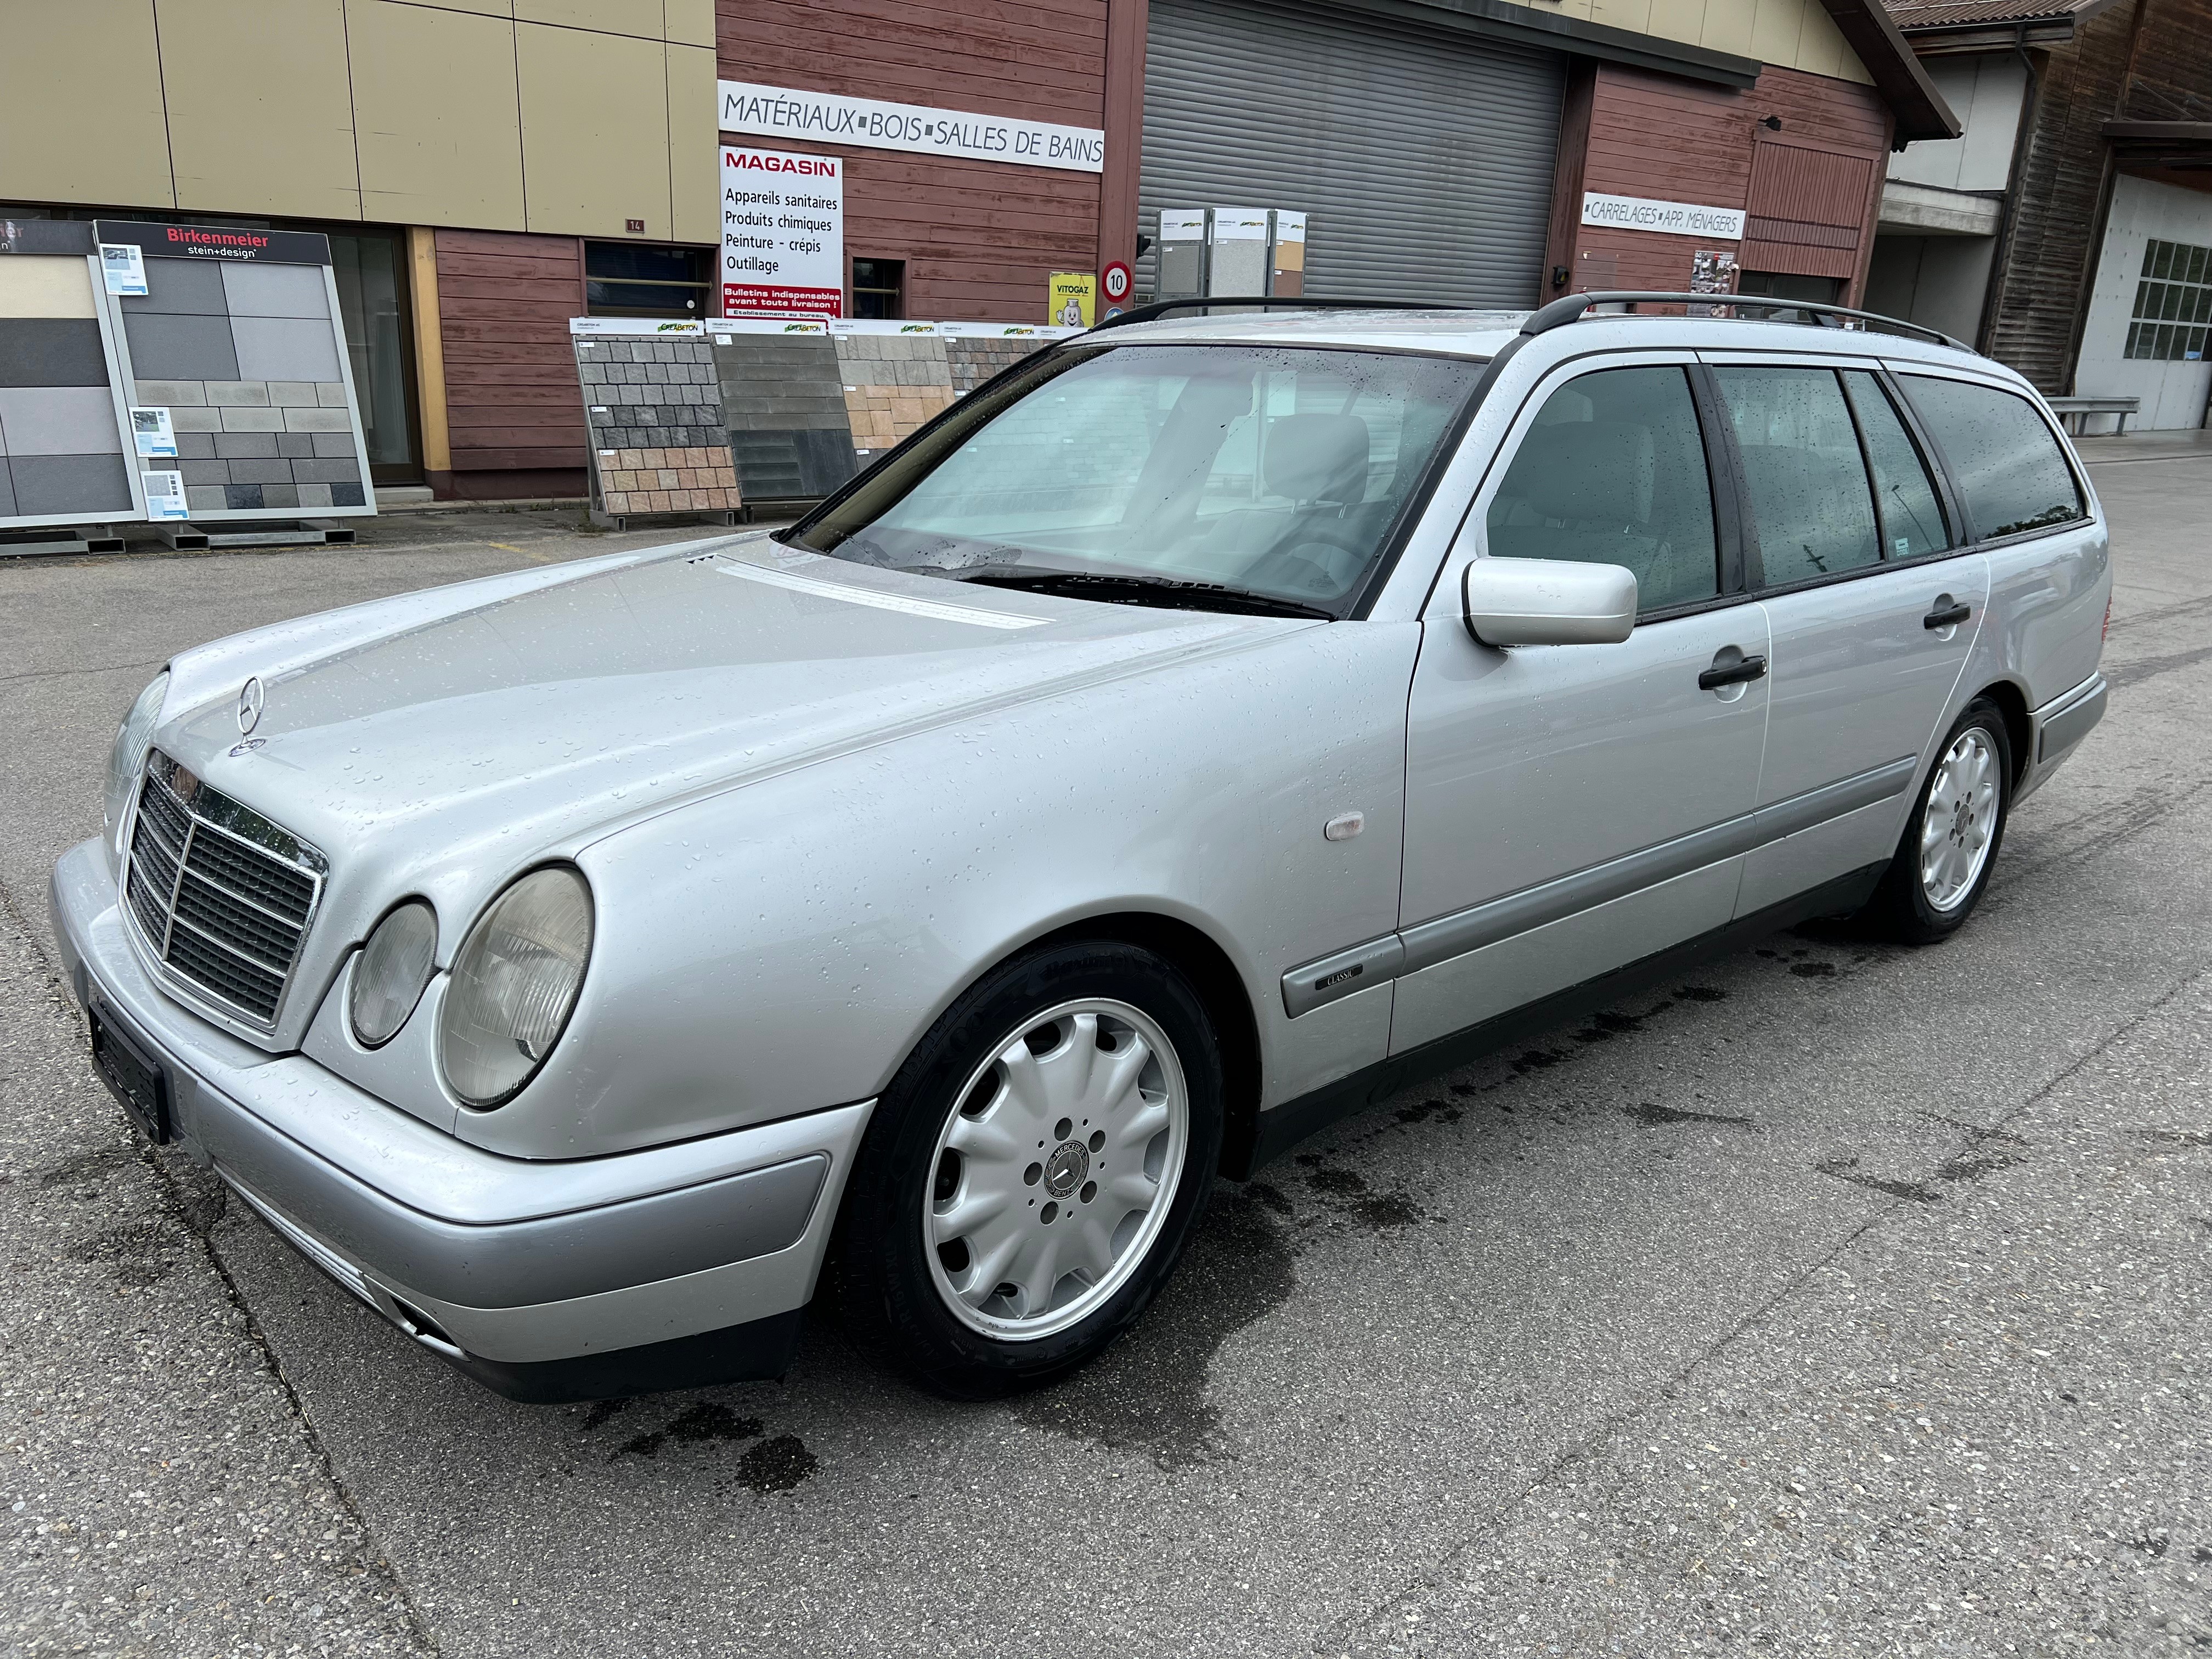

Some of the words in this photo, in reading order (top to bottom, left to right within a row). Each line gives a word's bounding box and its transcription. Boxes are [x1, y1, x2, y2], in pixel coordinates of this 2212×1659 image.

[724, 93, 856, 135] MATÉRIAUX
[869, 112, 922, 142] BOIS
[934, 120, 1007, 152] SALLES
[1015, 130, 1042, 156] DE
[1048, 134, 1103, 163] BAINS
[726, 153, 835, 177] MAGASIN
[725, 188, 780, 206] Appareils
[785, 194, 838, 210] sanitaires
[630, 221, 640, 230] 14
[725, 211, 774, 227] Produits
[778, 214, 832, 234] chimiques
[1590, 201, 1657, 224] CARRELAGES
[1662, 210, 1683, 228] APP.
[1686, 209, 1737, 233] MÉNAGERS
[166, 228, 269, 247] Birkenmeier
[726, 233, 774, 250] Peinture
[789, 237, 821, 255] crépis
[727, 256, 779, 275] Outillage
[1110, 274, 1124, 291] 10
[724, 288, 769, 298] Bulletins
[771, 290, 840, 301] indispensables
[761, 298, 789, 307] toute
[792, 300, 831, 309] livraison
[1327, 968, 1354, 986] CLASSIC
[1054, 1143, 1085, 1158] MERCEDES
